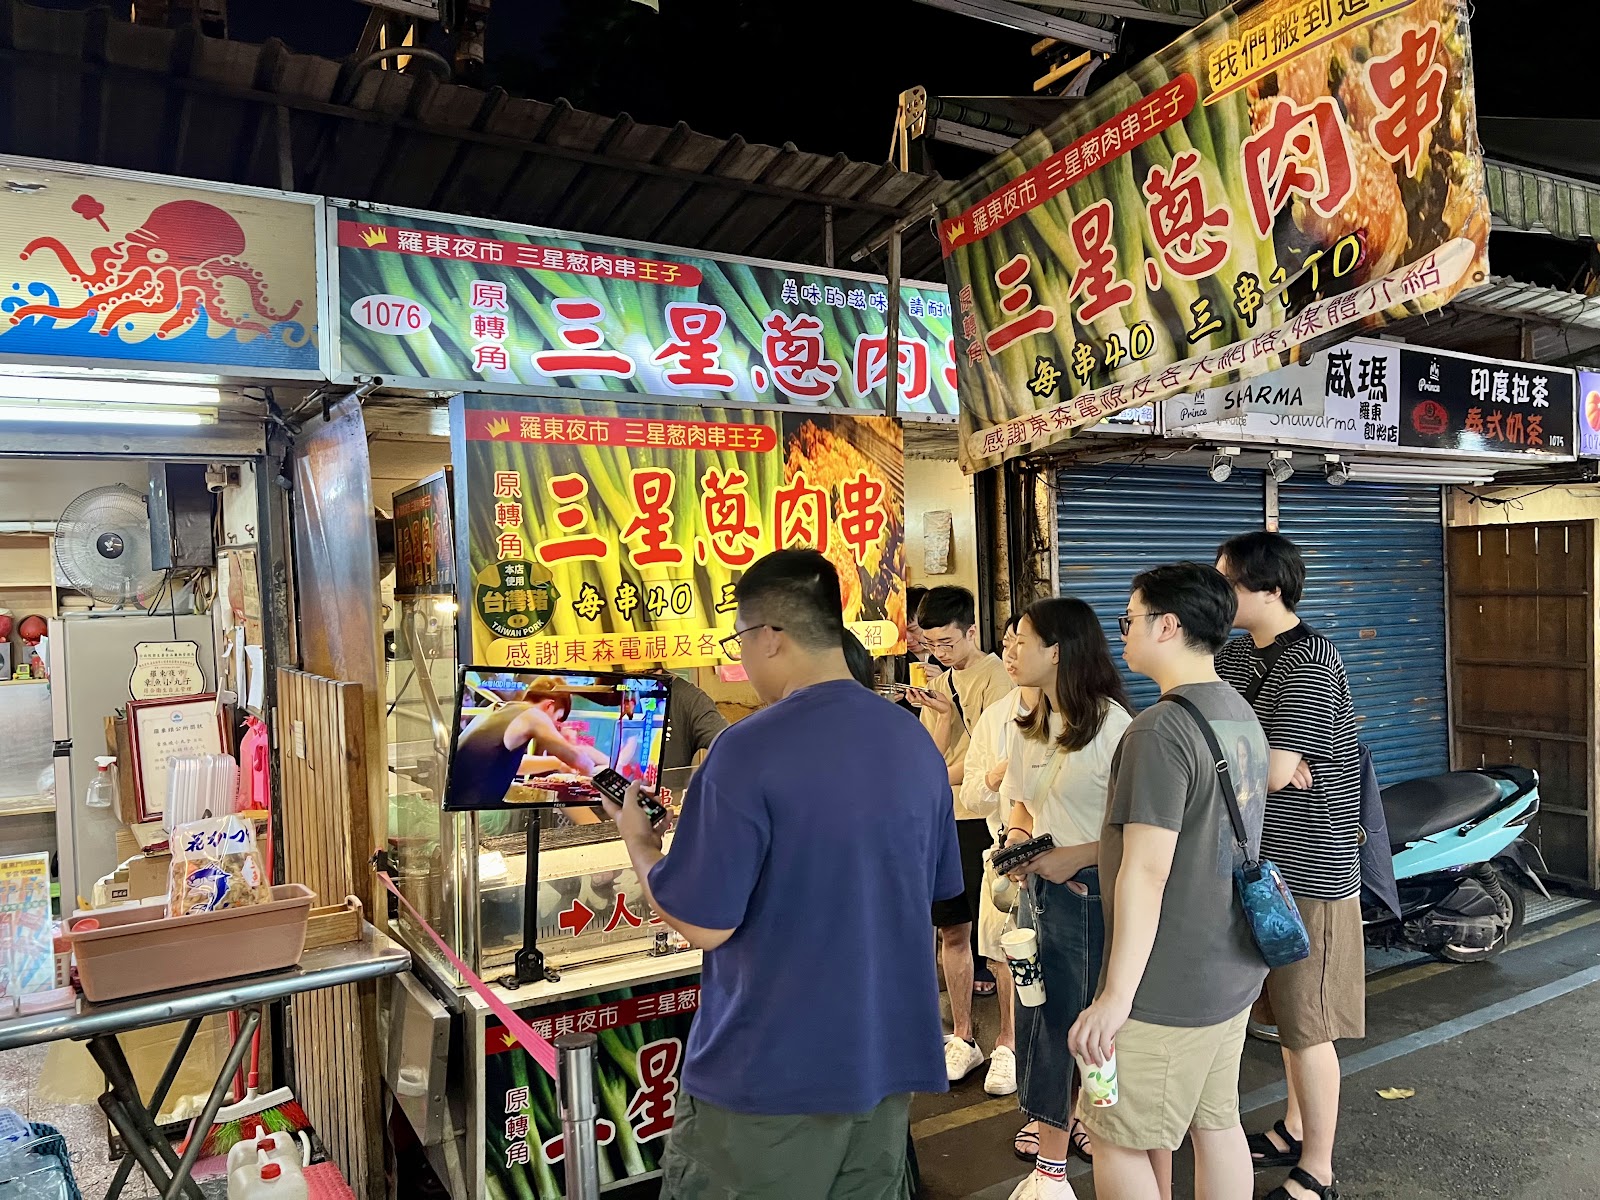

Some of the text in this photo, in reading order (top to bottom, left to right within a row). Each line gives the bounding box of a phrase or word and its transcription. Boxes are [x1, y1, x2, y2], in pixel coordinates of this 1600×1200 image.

[1212, 0, 1386, 87] 我們搬到
[971, 177, 1037, 236] 羅東夜市
[396, 229, 504, 264] 羅東夜市
[360, 298, 422, 331] 1076
[909, 297, 952, 318] 請耐
[470, 280, 510, 374] 原轉角
[958, 284, 984, 368] 原轉角
[1027, 322, 1156, 397] 每串40
[1418, 378, 1441, 393] Prince
[1470, 368, 1549, 408] 印度拉茶
[1180, 408, 1208, 421] Prince
[1359, 401, 1382, 421] 羅東
[1465, 406, 1543, 445] 泰式奶茶
[519, 416, 609, 443] 羅東夜市
[1583, 433, 1600, 450] 107
[494, 471, 523, 560] 原轉角
[505, 564, 524, 575] 本店
[505, 577, 524, 587] 使用
[483, 589, 548, 613] 台灣豬
[574, 582, 693, 622] 每串40
[491, 619, 545, 638] TAIWAN PORK
[185, 828, 251, 852] 花かつ
[637, 989, 701, 1019] 三星葱
[532, 1006, 619, 1041] 羅東夜市
[505, 1086, 529, 1169] 原轉角
